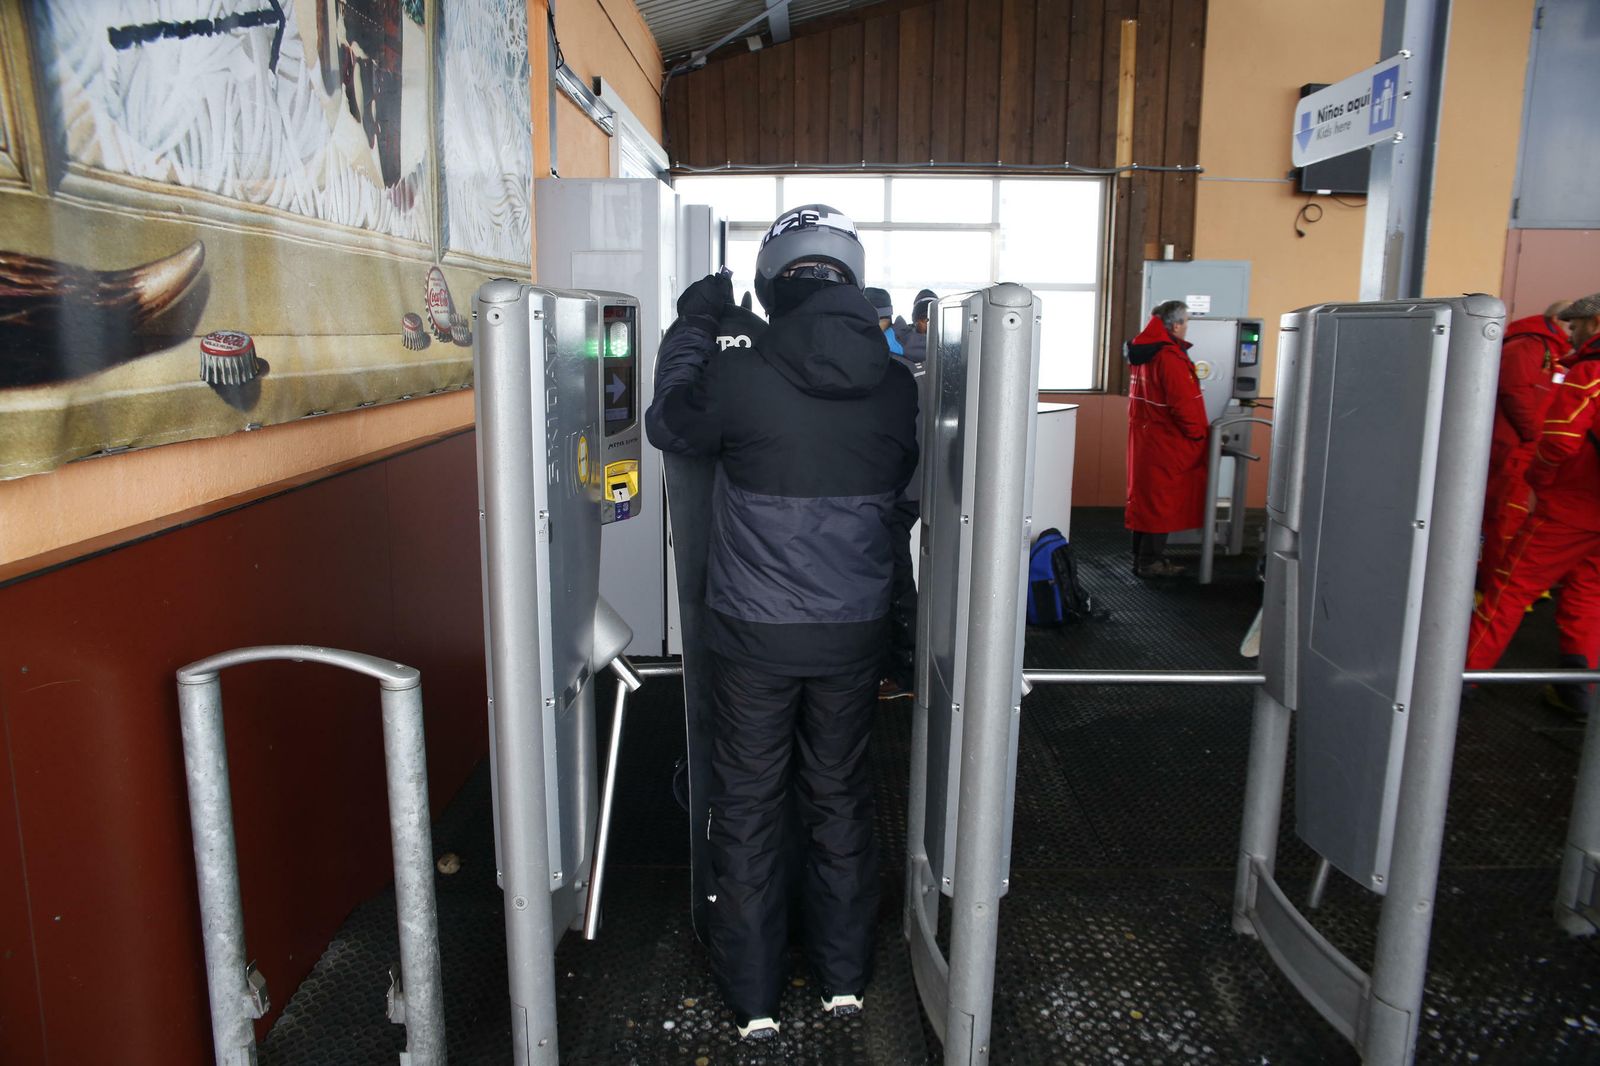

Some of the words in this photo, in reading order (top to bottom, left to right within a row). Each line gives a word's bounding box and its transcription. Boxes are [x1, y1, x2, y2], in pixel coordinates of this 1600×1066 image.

[1317, 104, 1344, 124] Niños
[1347, 87, 1371, 114] aquí
[1317, 123, 1332, 140] Kids
[1335, 120, 1352, 134] here
